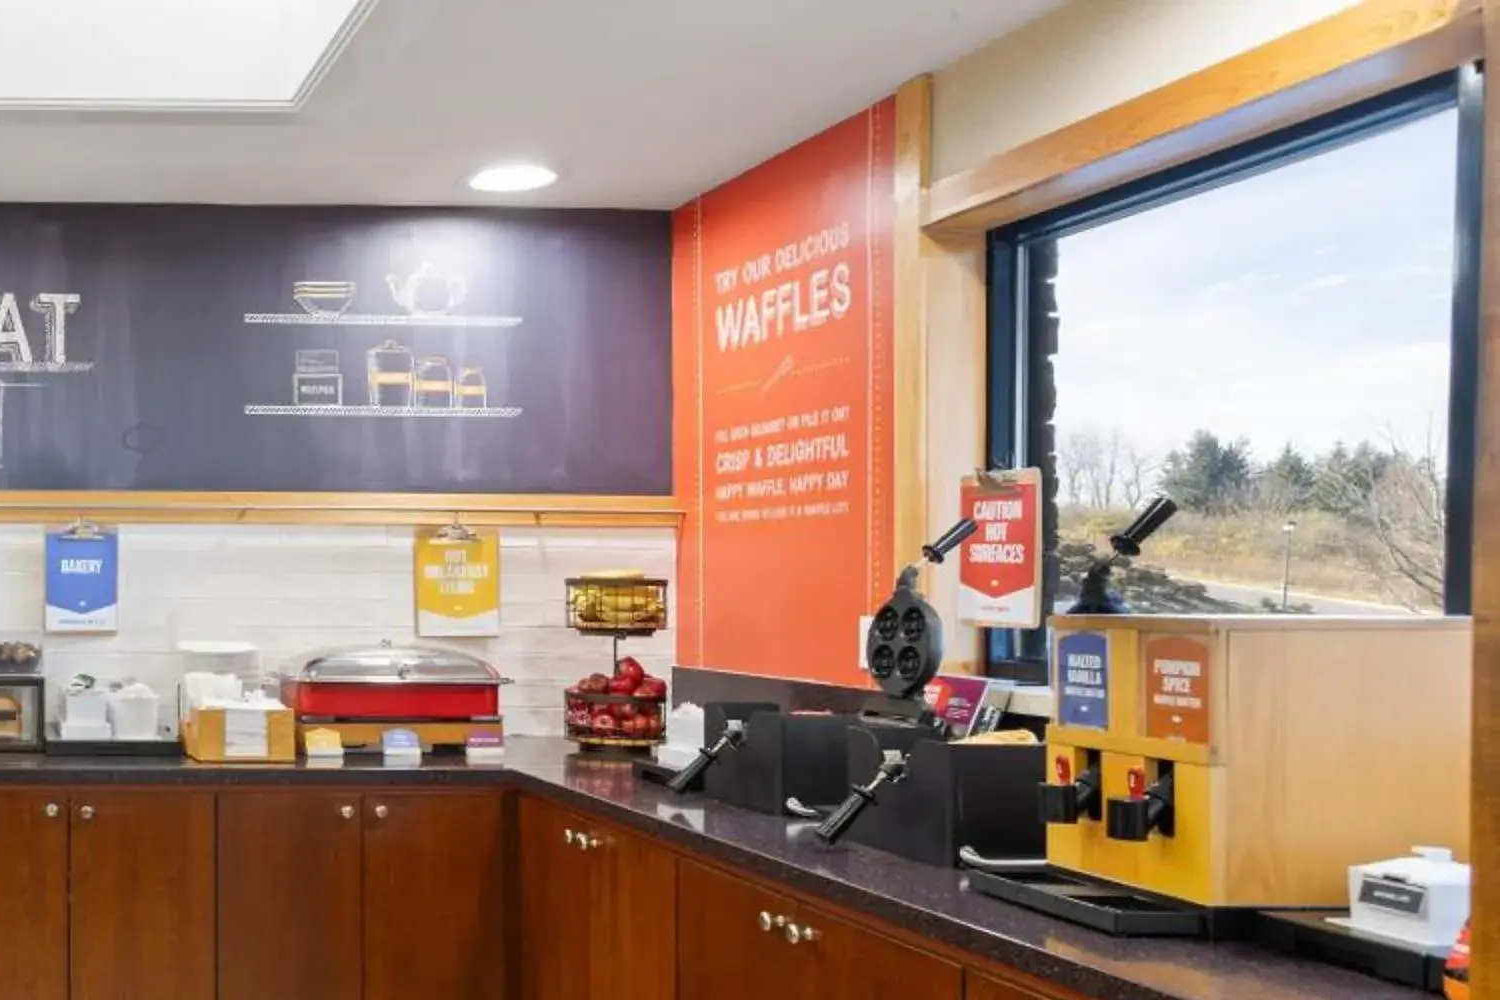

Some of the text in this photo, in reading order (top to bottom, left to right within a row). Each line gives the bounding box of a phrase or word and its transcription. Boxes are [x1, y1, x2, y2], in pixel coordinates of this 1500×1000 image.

[715, 221, 849, 296] TRY OUR DELICIOUS
[715, 262, 851, 353] WAFFLES
[716, 448, 750, 474] CRISP
[766, 432, 849, 468] DELIGHTFUL
[789, 472, 825, 495] HAPPY
[827, 469, 849, 491] DAY
[973, 499, 1023, 520] CAUTION
[985, 521, 1008, 542] HOT
[968, 543, 1025, 564] SURFACES
[60, 558, 104, 575] BAKERY
[1153, 658, 1201, 677] PUMPKIN
[1162, 675, 1192, 694] SPICE
